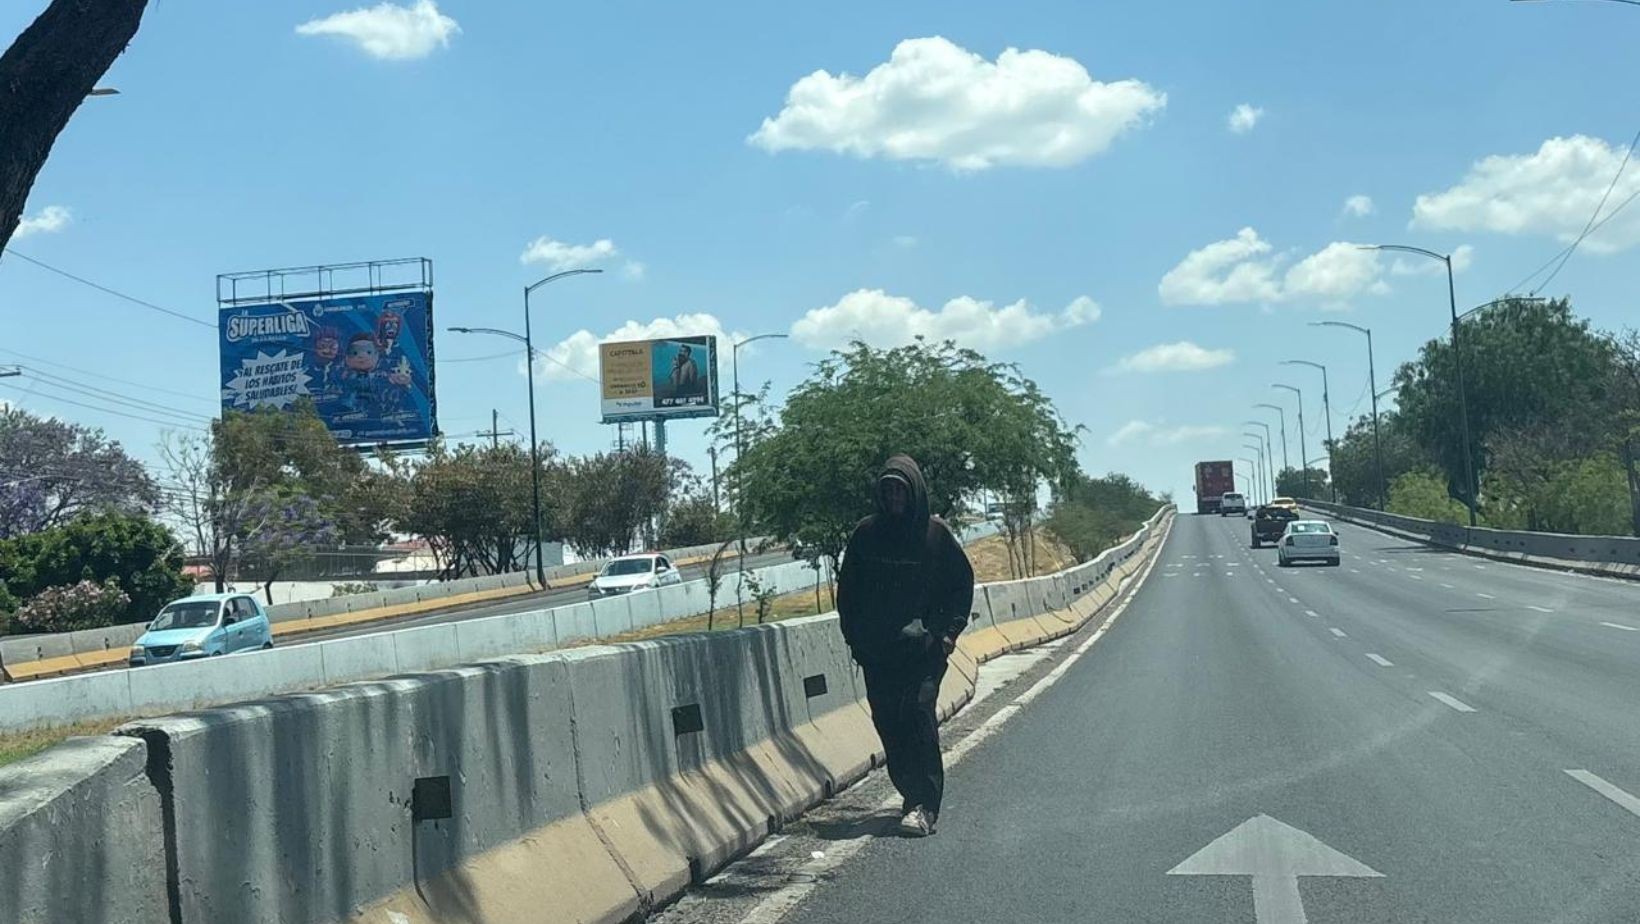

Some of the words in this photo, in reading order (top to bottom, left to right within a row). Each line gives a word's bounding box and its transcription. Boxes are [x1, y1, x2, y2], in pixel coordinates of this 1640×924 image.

[229, 312, 307, 338] SUPERLIGA
[254, 360, 289, 375] RESCATE
[290, 359, 302, 370] DE
[245, 377, 261, 389] LOS
[245, 384, 298, 401] SALUDABLES!
